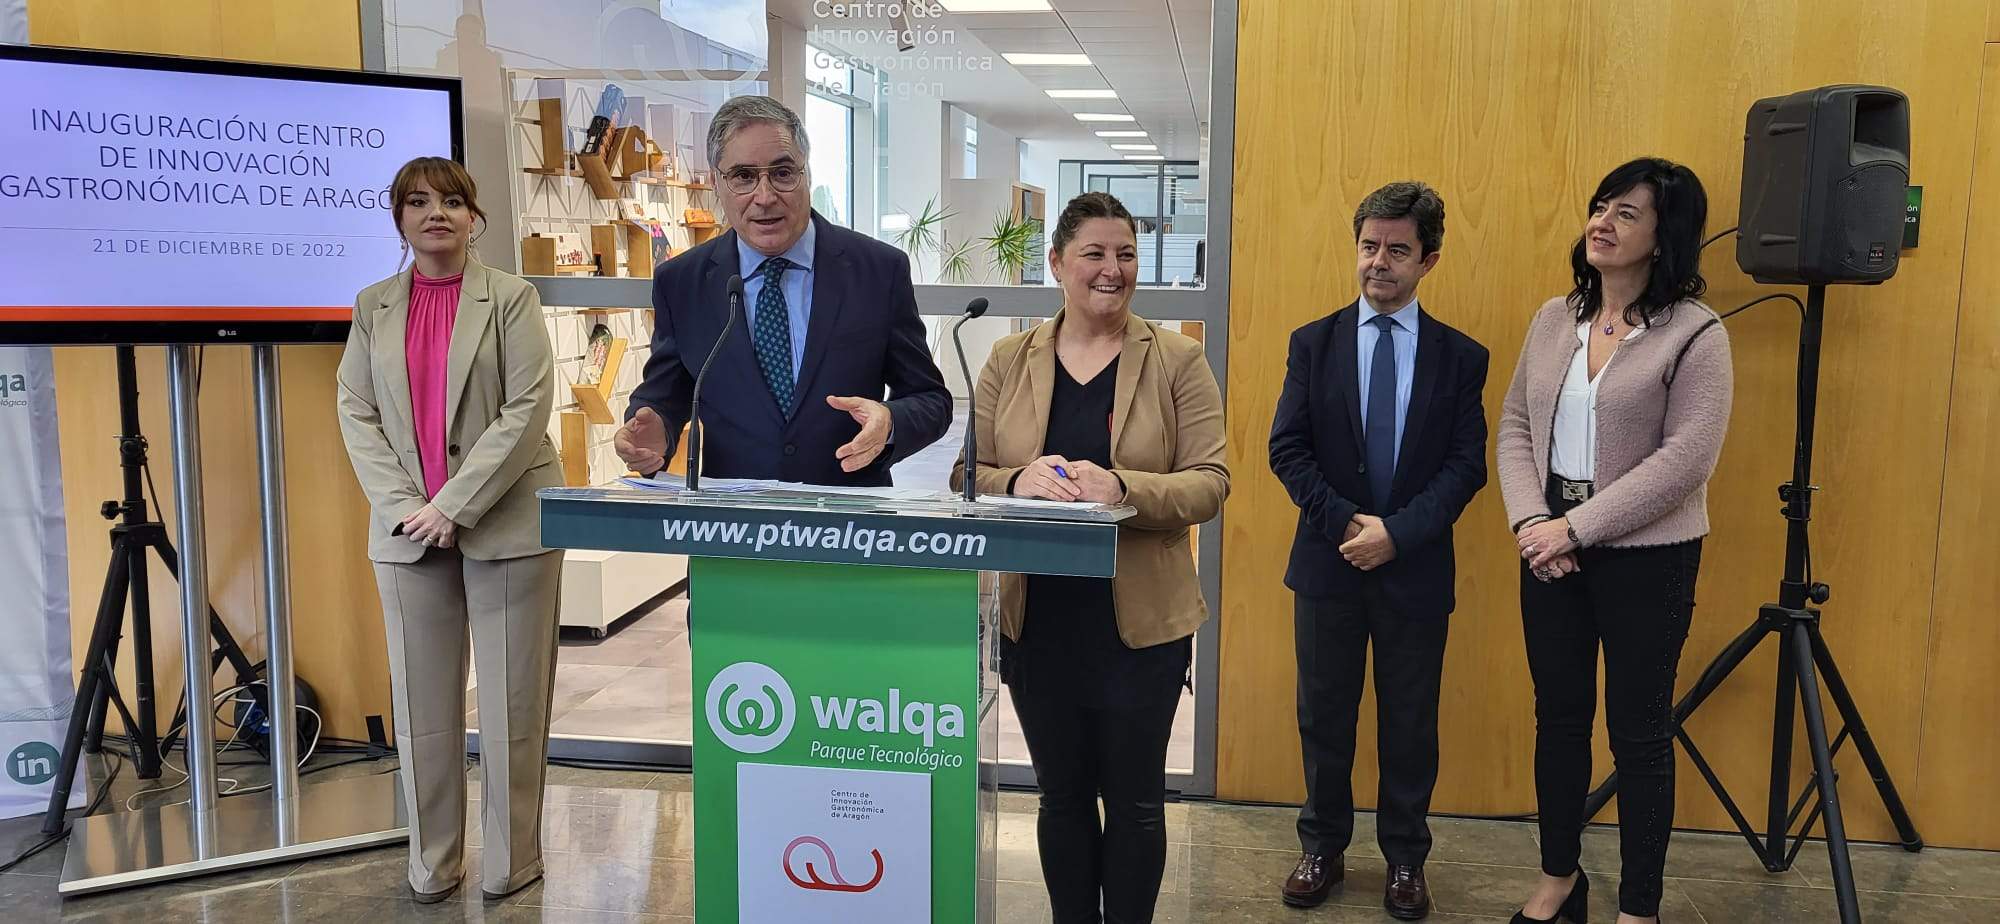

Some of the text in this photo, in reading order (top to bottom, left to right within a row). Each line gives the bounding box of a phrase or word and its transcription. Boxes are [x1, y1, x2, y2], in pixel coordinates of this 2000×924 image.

[812, 0, 943, 19] Centro de
[813, 24, 955, 45] Innovación
[813, 50, 993, 72] Gastronómica
[815, 76, 843, 96] de
[31, 107, 385, 149] INAUGURACIÓN CENTRO
[99, 145, 330, 177] DE INNOVACIÓN
[0, 174, 393, 210] GASTRONÓMICA DE ARAGÓ
[92, 238, 346, 258] 21 DE DICIEMBRE DE 2022
[662, 518, 987, 558] www.ptwalqa.com
[810, 688, 965, 748] walqa
[16, 752, 51, 778] in
[810, 741, 963, 771] Parque Tecnológico
[831, 789, 857, 798] Centro
[831, 797, 873, 805] Innovación
[831, 804, 884, 813] Gastronómica
[843, 812, 870, 820] Aragón
